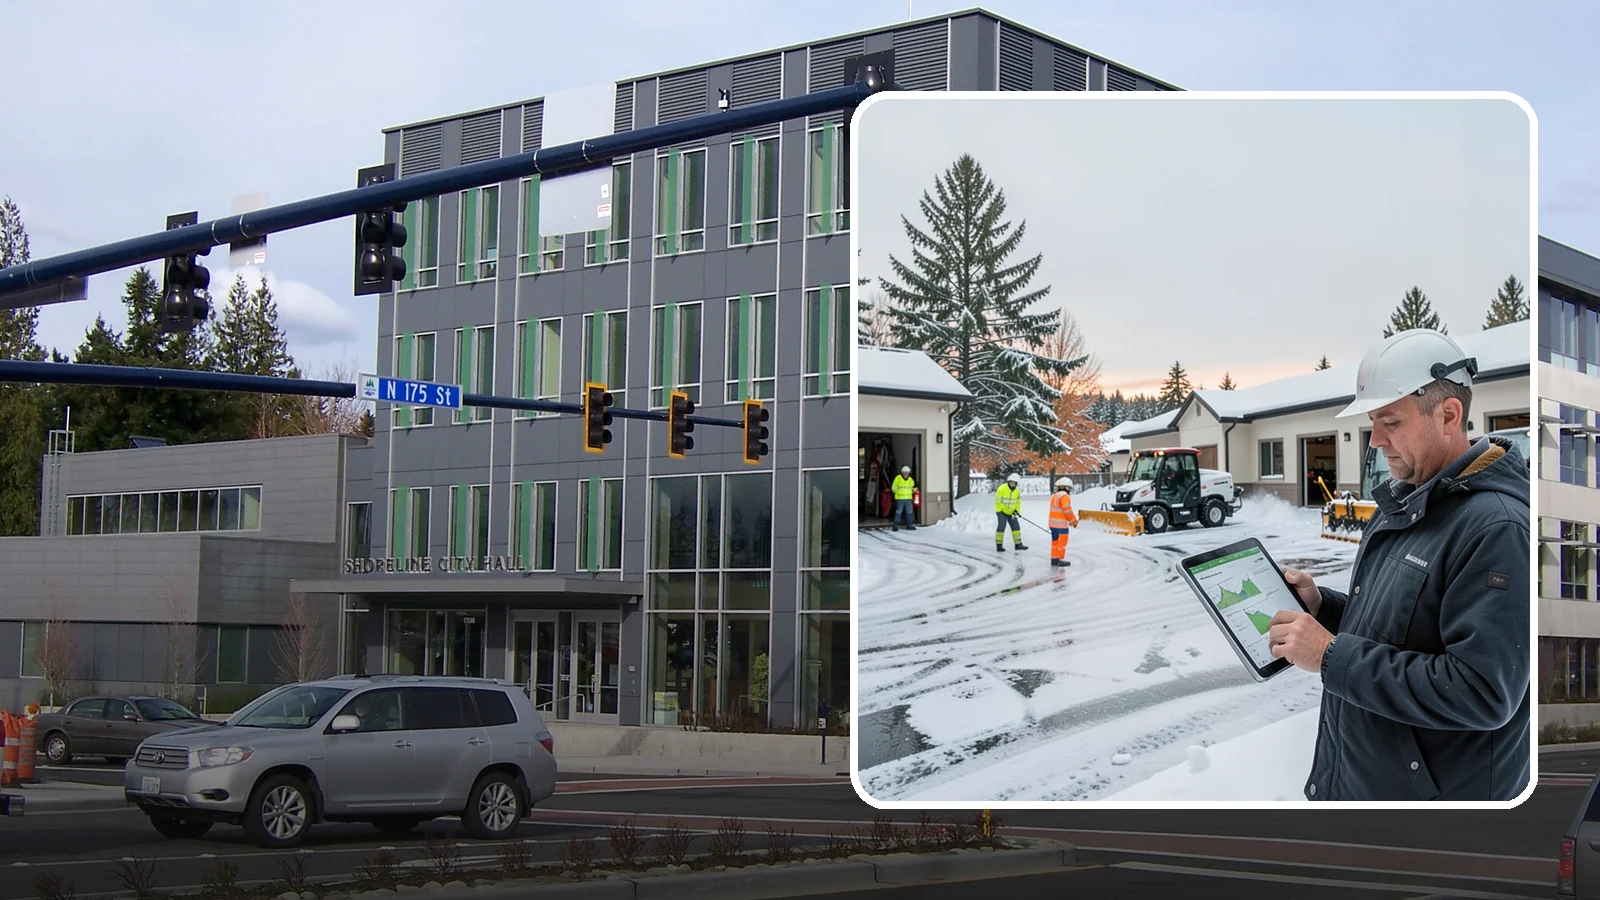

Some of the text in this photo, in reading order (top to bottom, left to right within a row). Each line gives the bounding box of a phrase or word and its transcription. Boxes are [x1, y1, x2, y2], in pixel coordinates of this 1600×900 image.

[387, 380, 451, 406] N 175 St
[344, 555, 525, 573] SHORELINE CITY HALL
